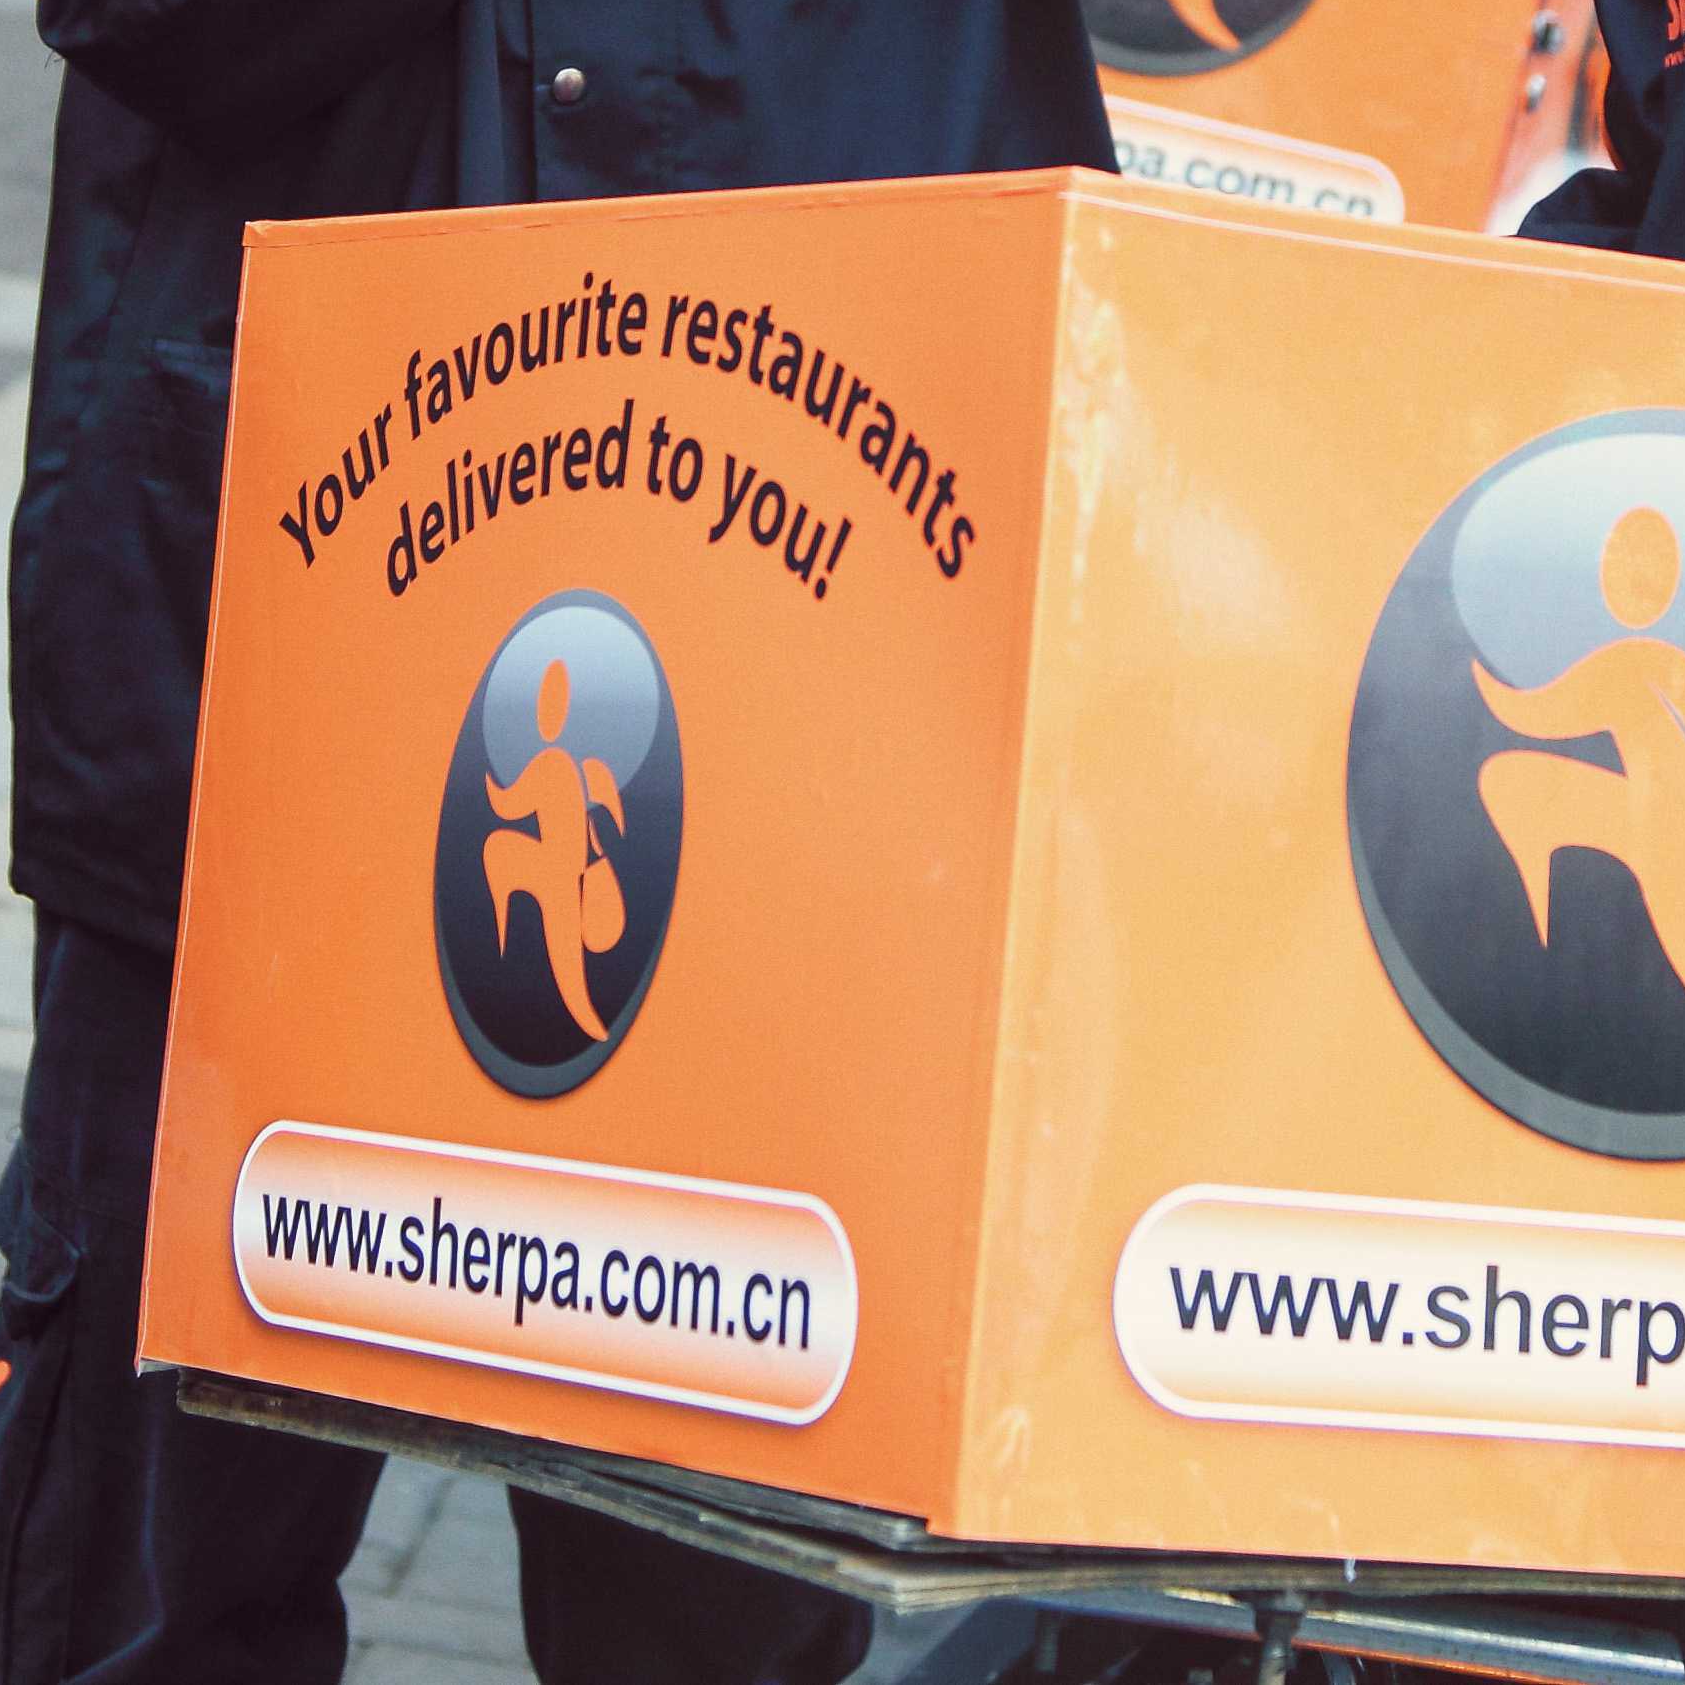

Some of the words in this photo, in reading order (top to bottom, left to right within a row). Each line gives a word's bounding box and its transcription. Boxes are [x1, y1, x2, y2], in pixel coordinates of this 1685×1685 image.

[279, 403, 392, 569] Your
[404, 272, 647, 441] favourite
[659, 293, 976, 579] restaurants
[386, 398, 636, 598] delivered
[647, 414, 704, 503] to
[707, 453, 854, 602] you!
[262, 1195, 811, 1350] www.sherpa.com.cn
